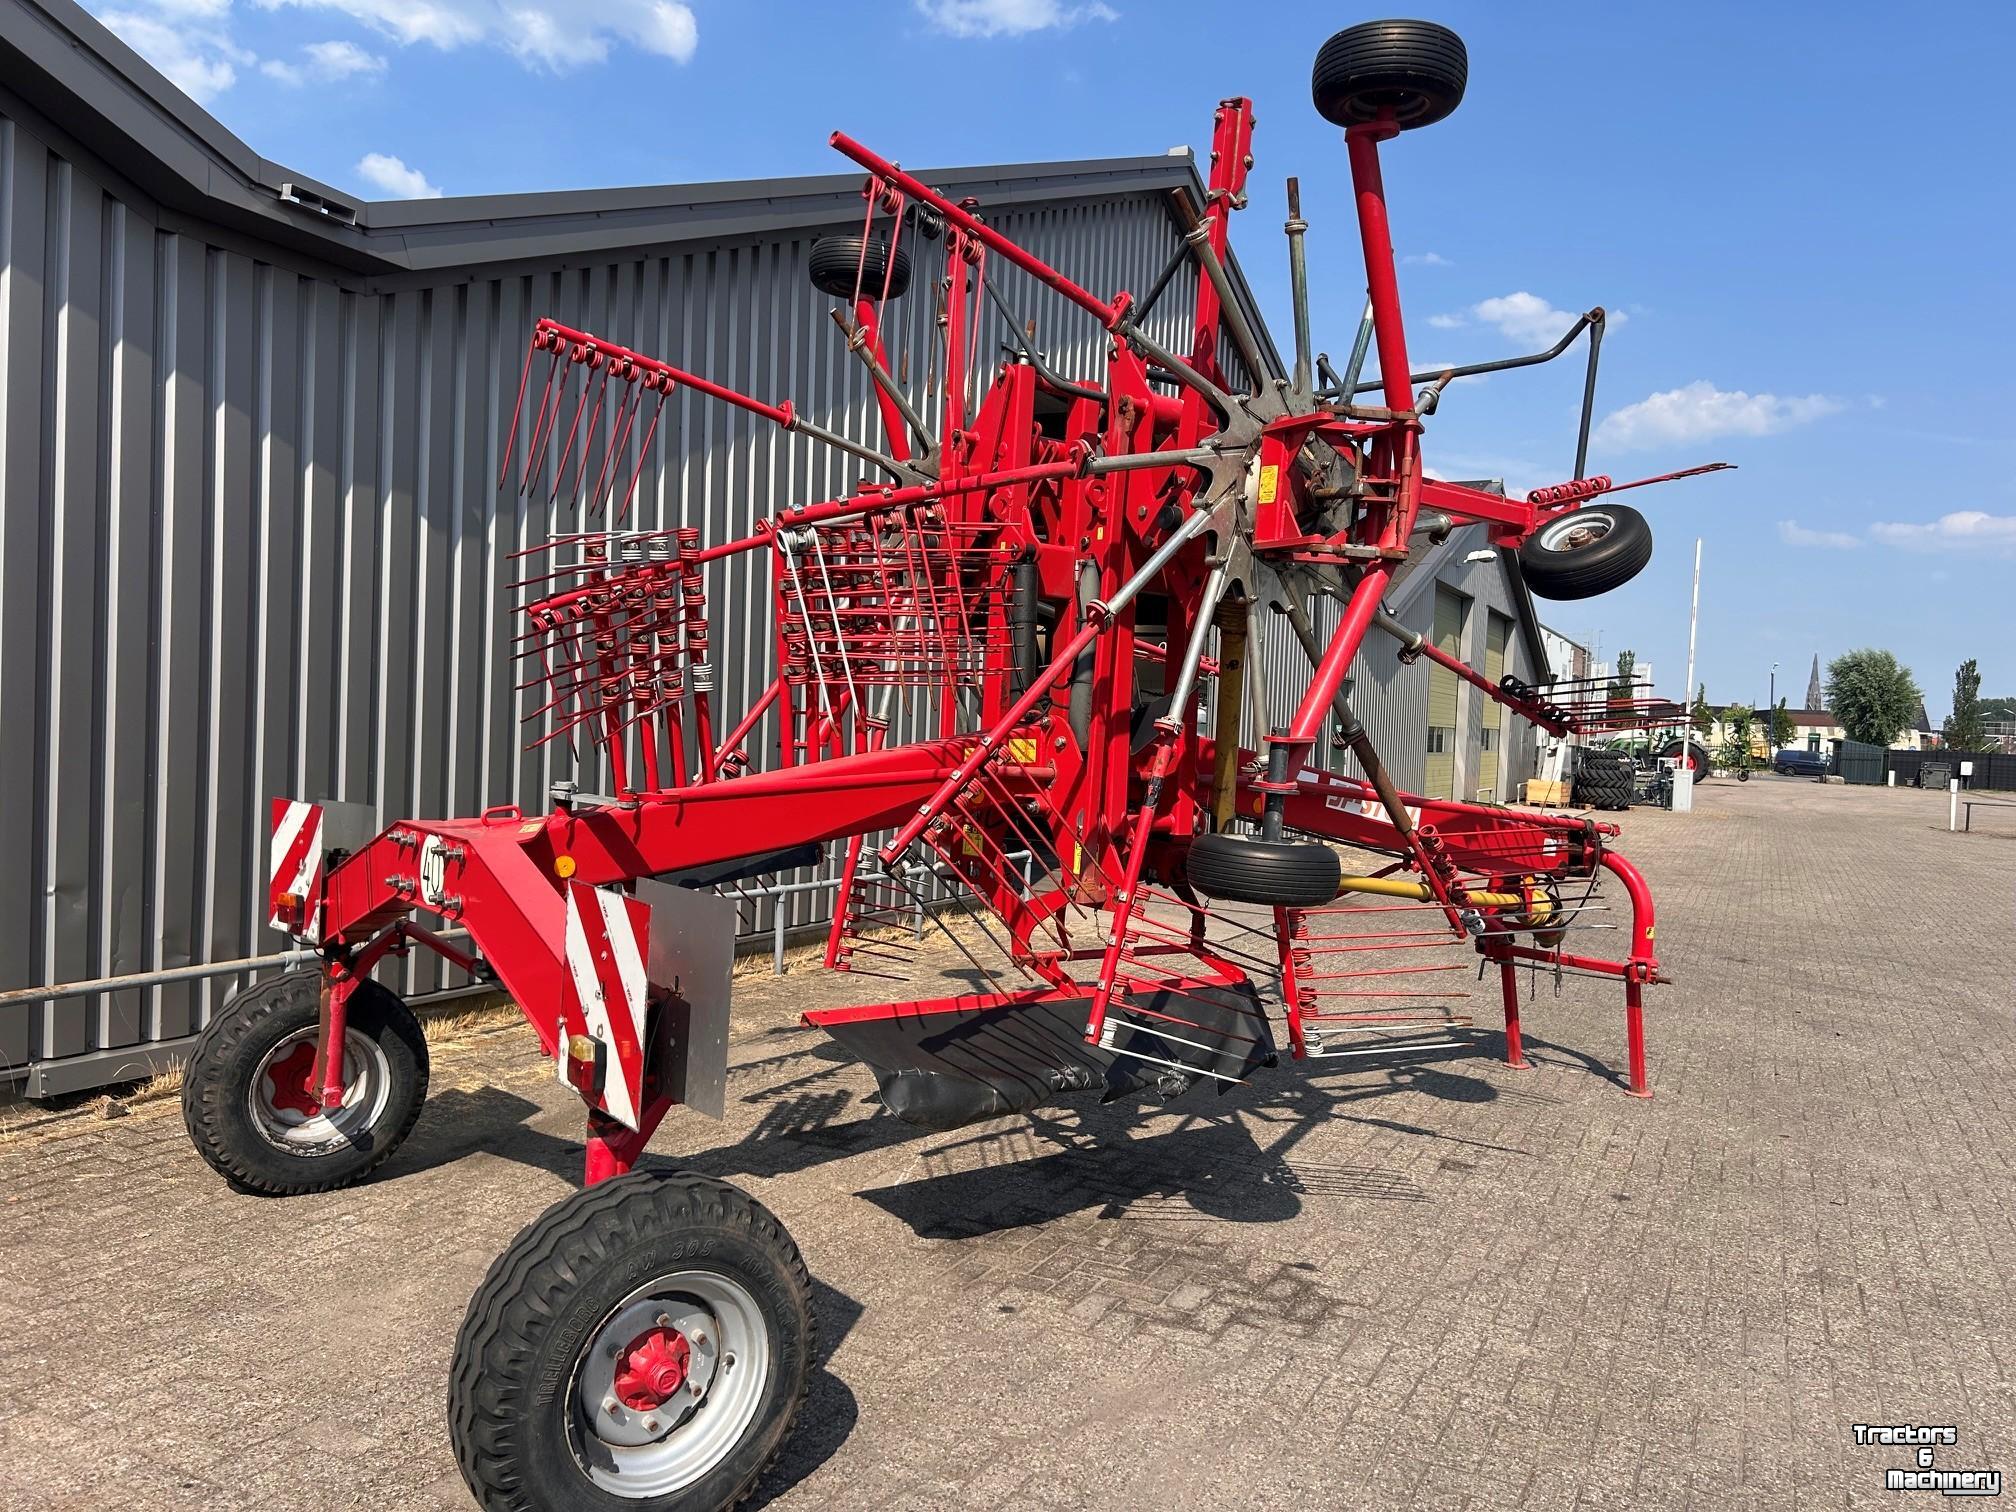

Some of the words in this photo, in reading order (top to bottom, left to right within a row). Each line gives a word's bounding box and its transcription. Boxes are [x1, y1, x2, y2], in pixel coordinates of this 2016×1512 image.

[423, 846, 440, 894] 40
[671, 1239, 716, 1260] 305
[536, 1296, 599, 1407] TRELLEBORG
